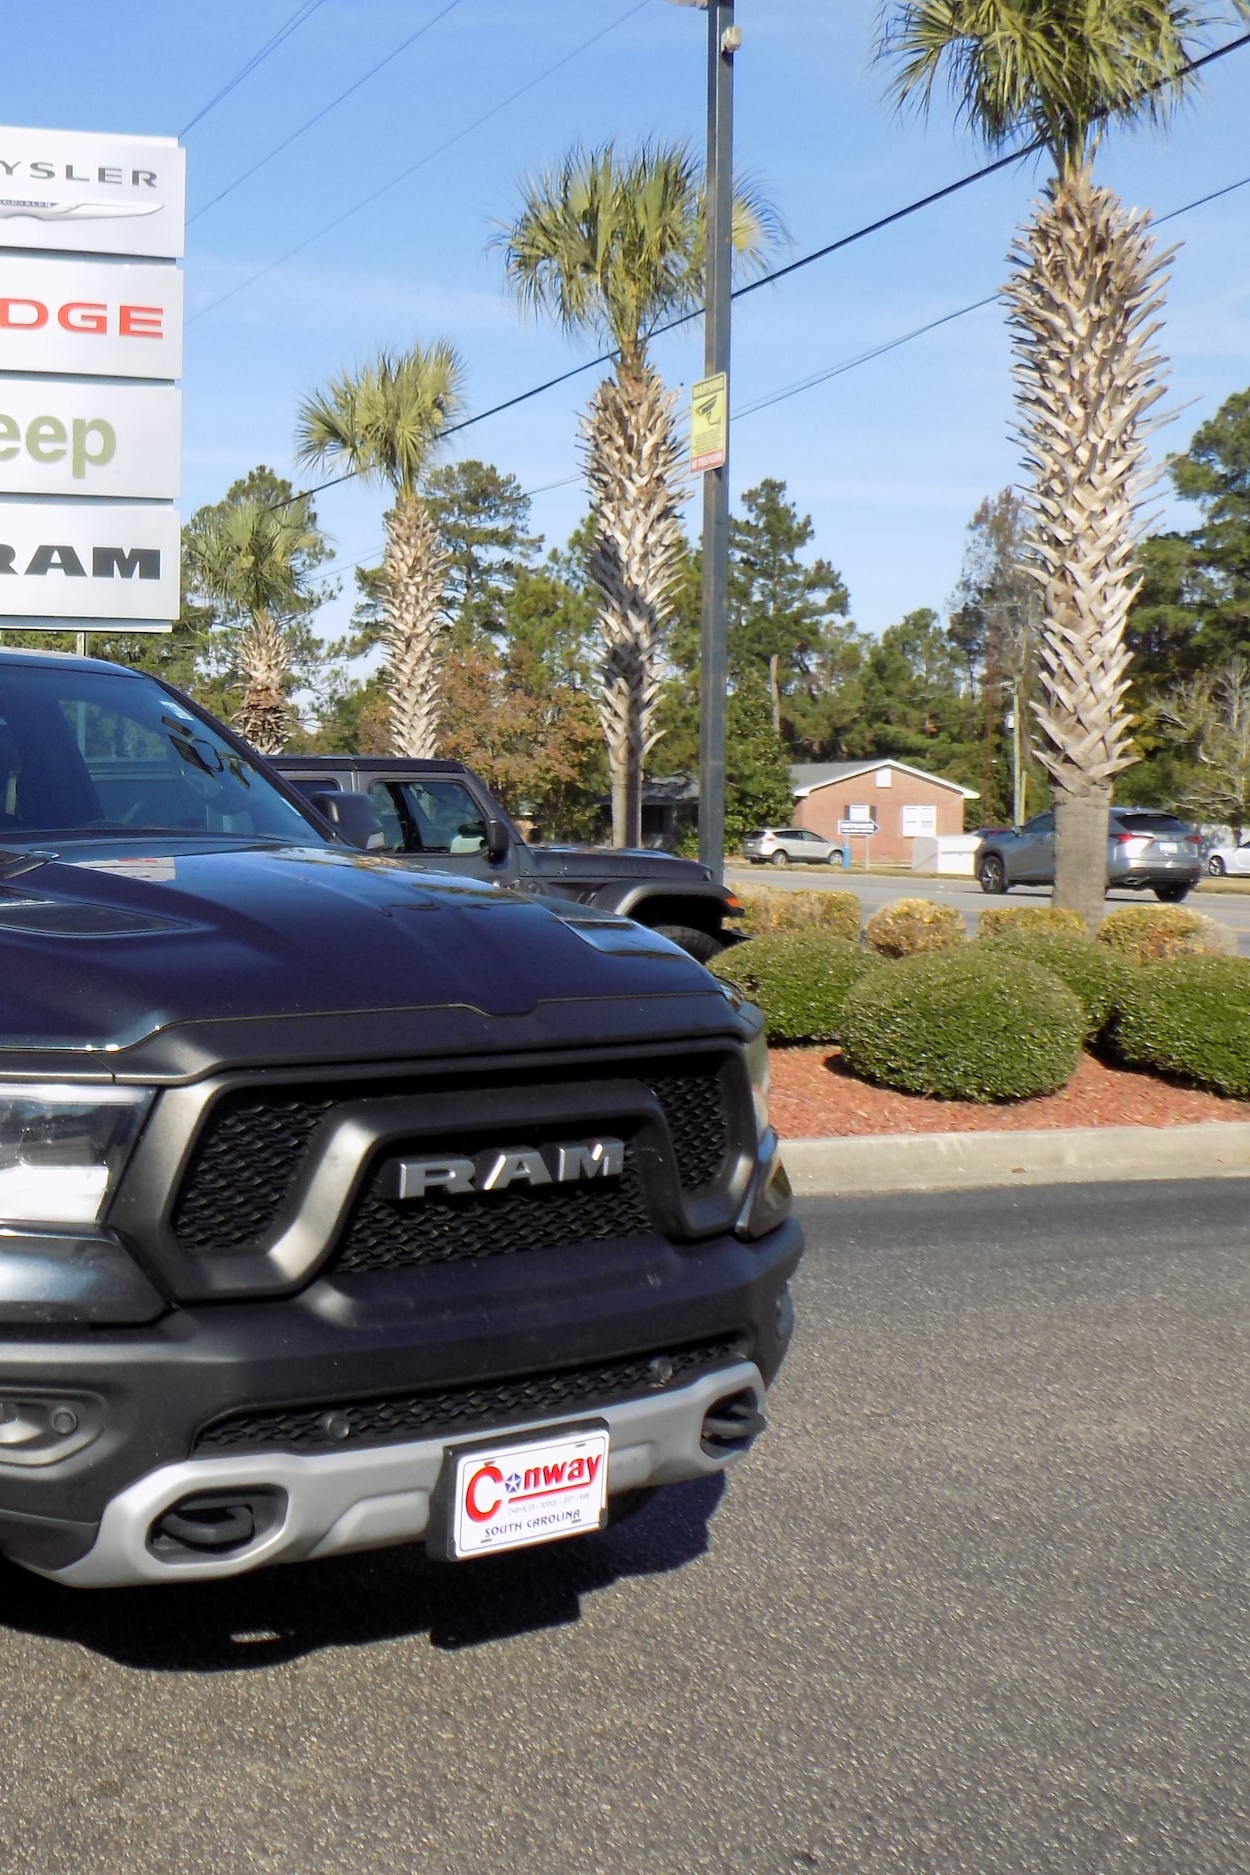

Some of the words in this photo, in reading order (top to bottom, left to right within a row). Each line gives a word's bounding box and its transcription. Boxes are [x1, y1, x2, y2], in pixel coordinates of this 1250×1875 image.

[399, 1138, 624, 1200] RAM
[484, 1518, 523, 1538] SOUTH
[526, 1508, 581, 1529] CAROLINA
